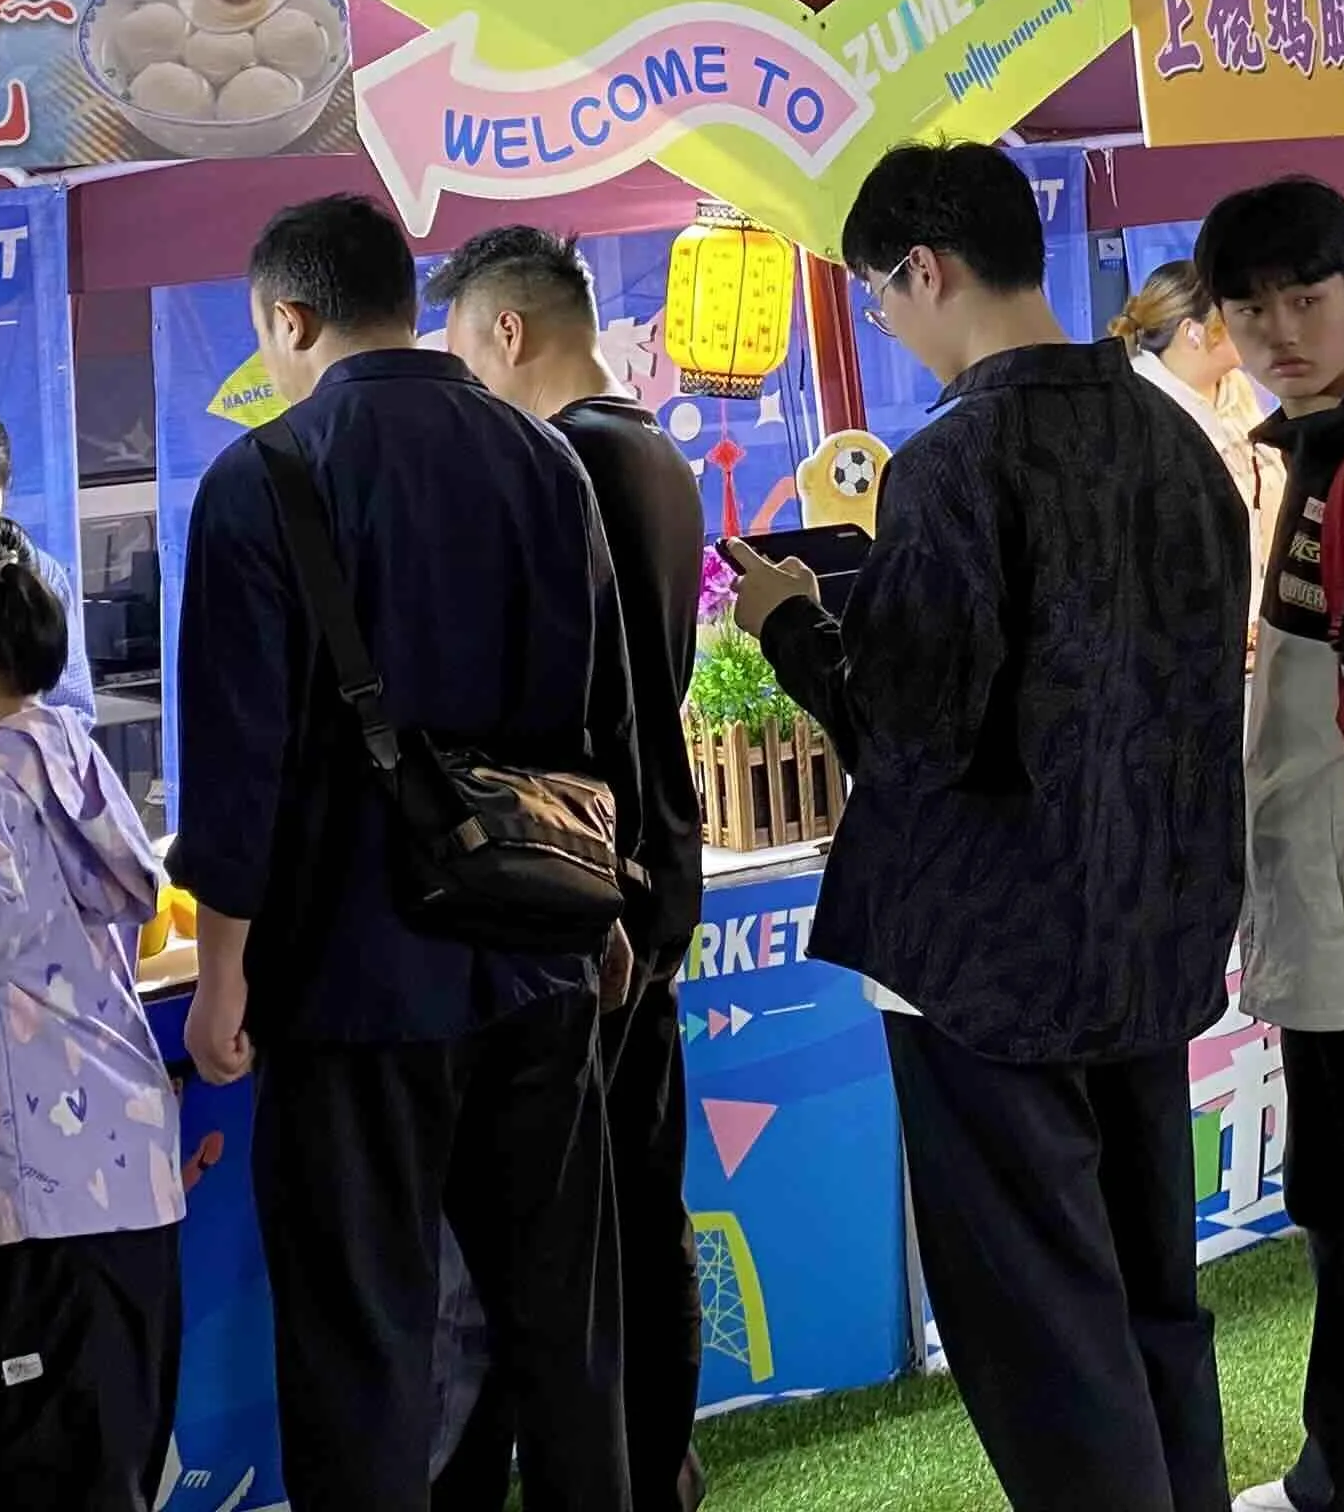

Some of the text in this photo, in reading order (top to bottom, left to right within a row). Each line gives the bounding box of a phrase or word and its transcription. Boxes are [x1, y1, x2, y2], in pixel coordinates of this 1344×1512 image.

[444, 45, 825, 169] WELCOME TO
[675, 905, 817, 983] RKET
